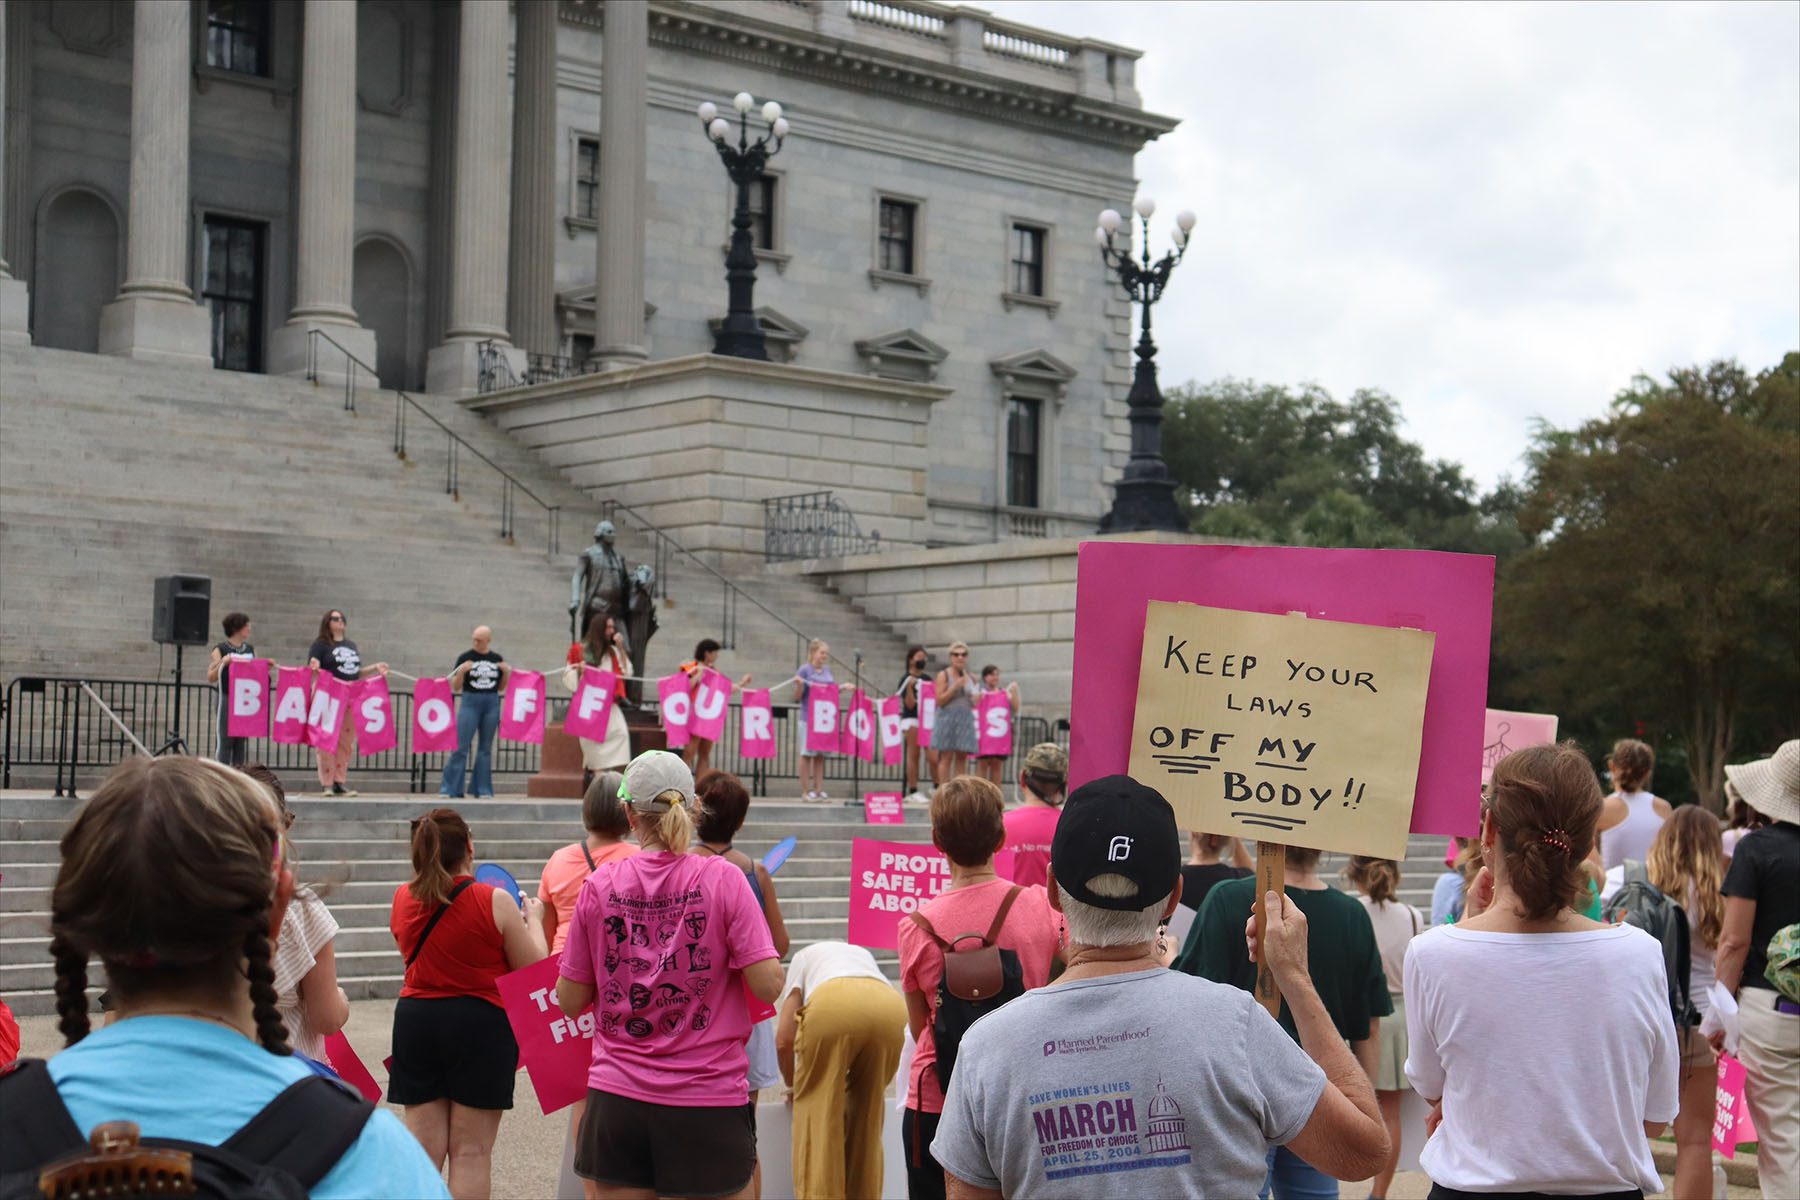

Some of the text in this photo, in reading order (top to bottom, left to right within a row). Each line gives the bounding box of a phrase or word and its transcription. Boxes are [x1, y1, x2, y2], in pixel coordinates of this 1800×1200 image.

[1163, 634, 1378, 693] KEEP YOUR
[233, 679, 1009, 749] BANS OFF OUR BODIS
[1227, 693, 1313, 718] LAWS
[1149, 725, 1317, 763] OFF MY
[862, 870, 922, 897] SAFE,
[1058, 1028, 1151, 1049] Planned Parenthood
[1029, 1081, 1131, 1105] SAVE WOMEN'S LIVES
[1032, 1098, 1138, 1144] MARCH
[1041, 1134, 1139, 1157] FOR FREEDOM OF CHOICE
[1043, 1146, 1142, 1168] APRIL 25, 2004
